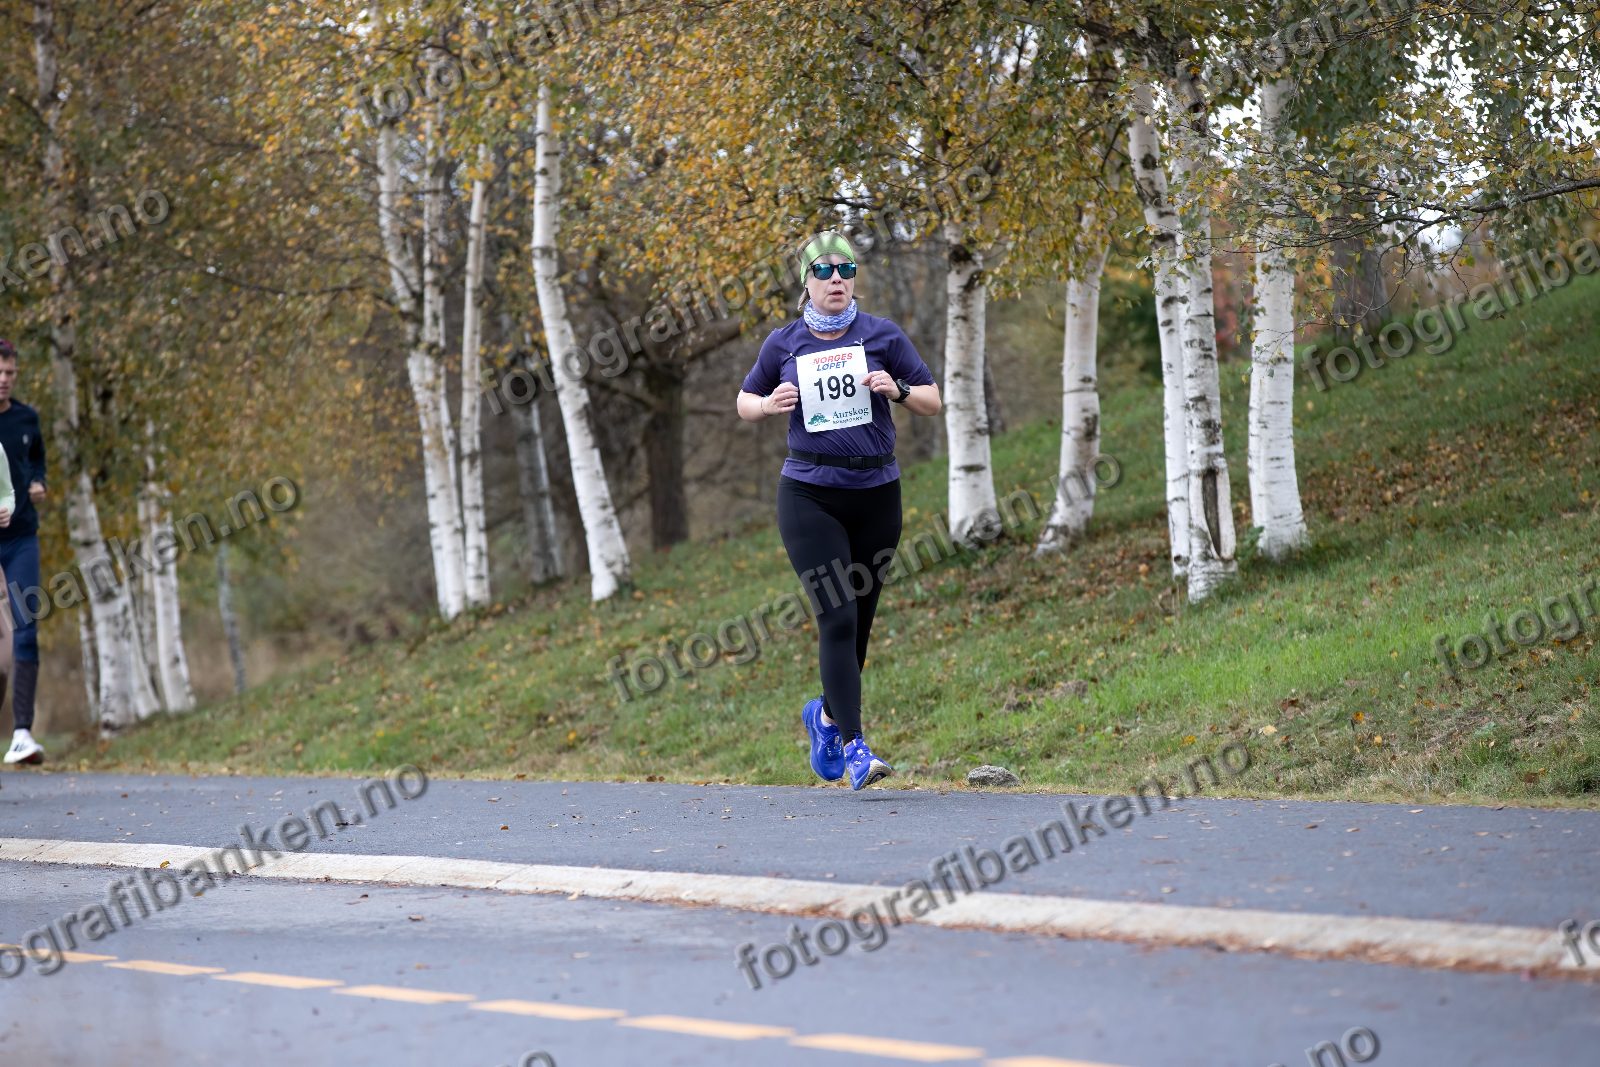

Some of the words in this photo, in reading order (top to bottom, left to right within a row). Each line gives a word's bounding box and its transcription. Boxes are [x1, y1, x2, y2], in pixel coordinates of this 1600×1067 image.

[813, 352, 853, 365] NORGES
[816, 360, 848, 371] LØPET
[813, 373, 857, 402] 198
[832, 407, 870, 419] Aurskog
